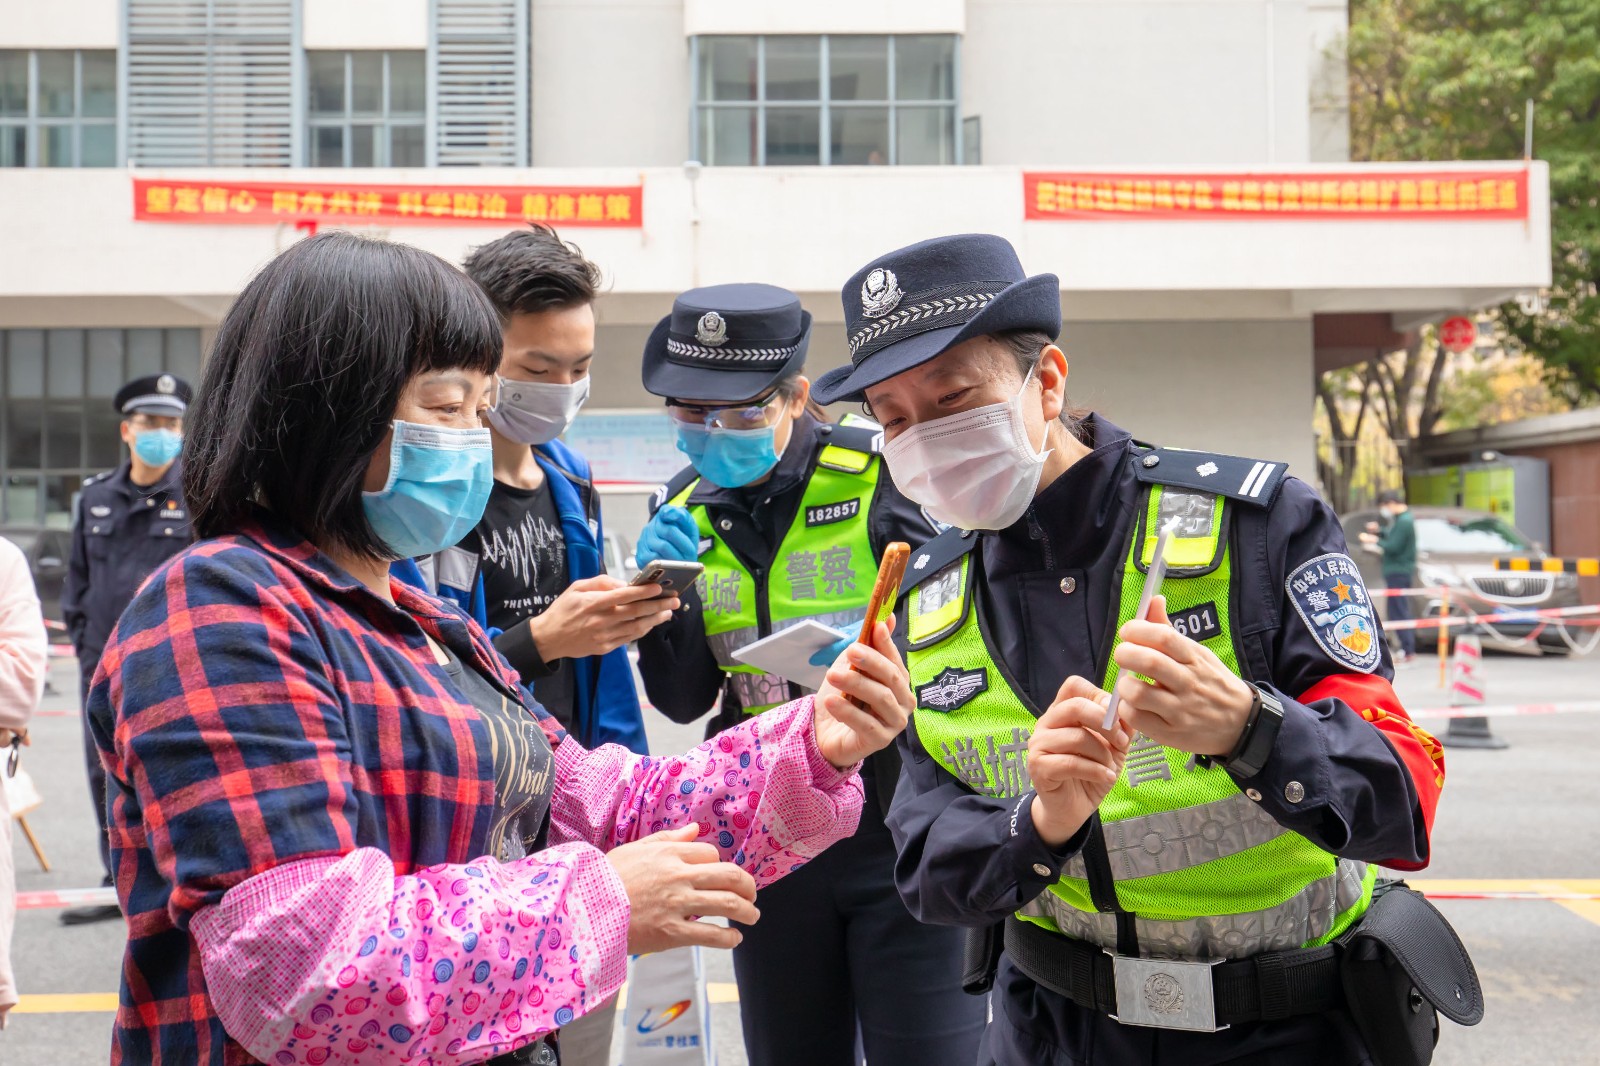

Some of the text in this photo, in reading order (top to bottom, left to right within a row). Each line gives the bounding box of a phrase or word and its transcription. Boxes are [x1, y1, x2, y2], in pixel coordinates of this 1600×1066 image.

[146, 187, 631, 220] 坚定信心 同舟共济 科学防治 精准施策
[808, 501, 858, 523] 182857
[786, 545, 856, 601] 警察
